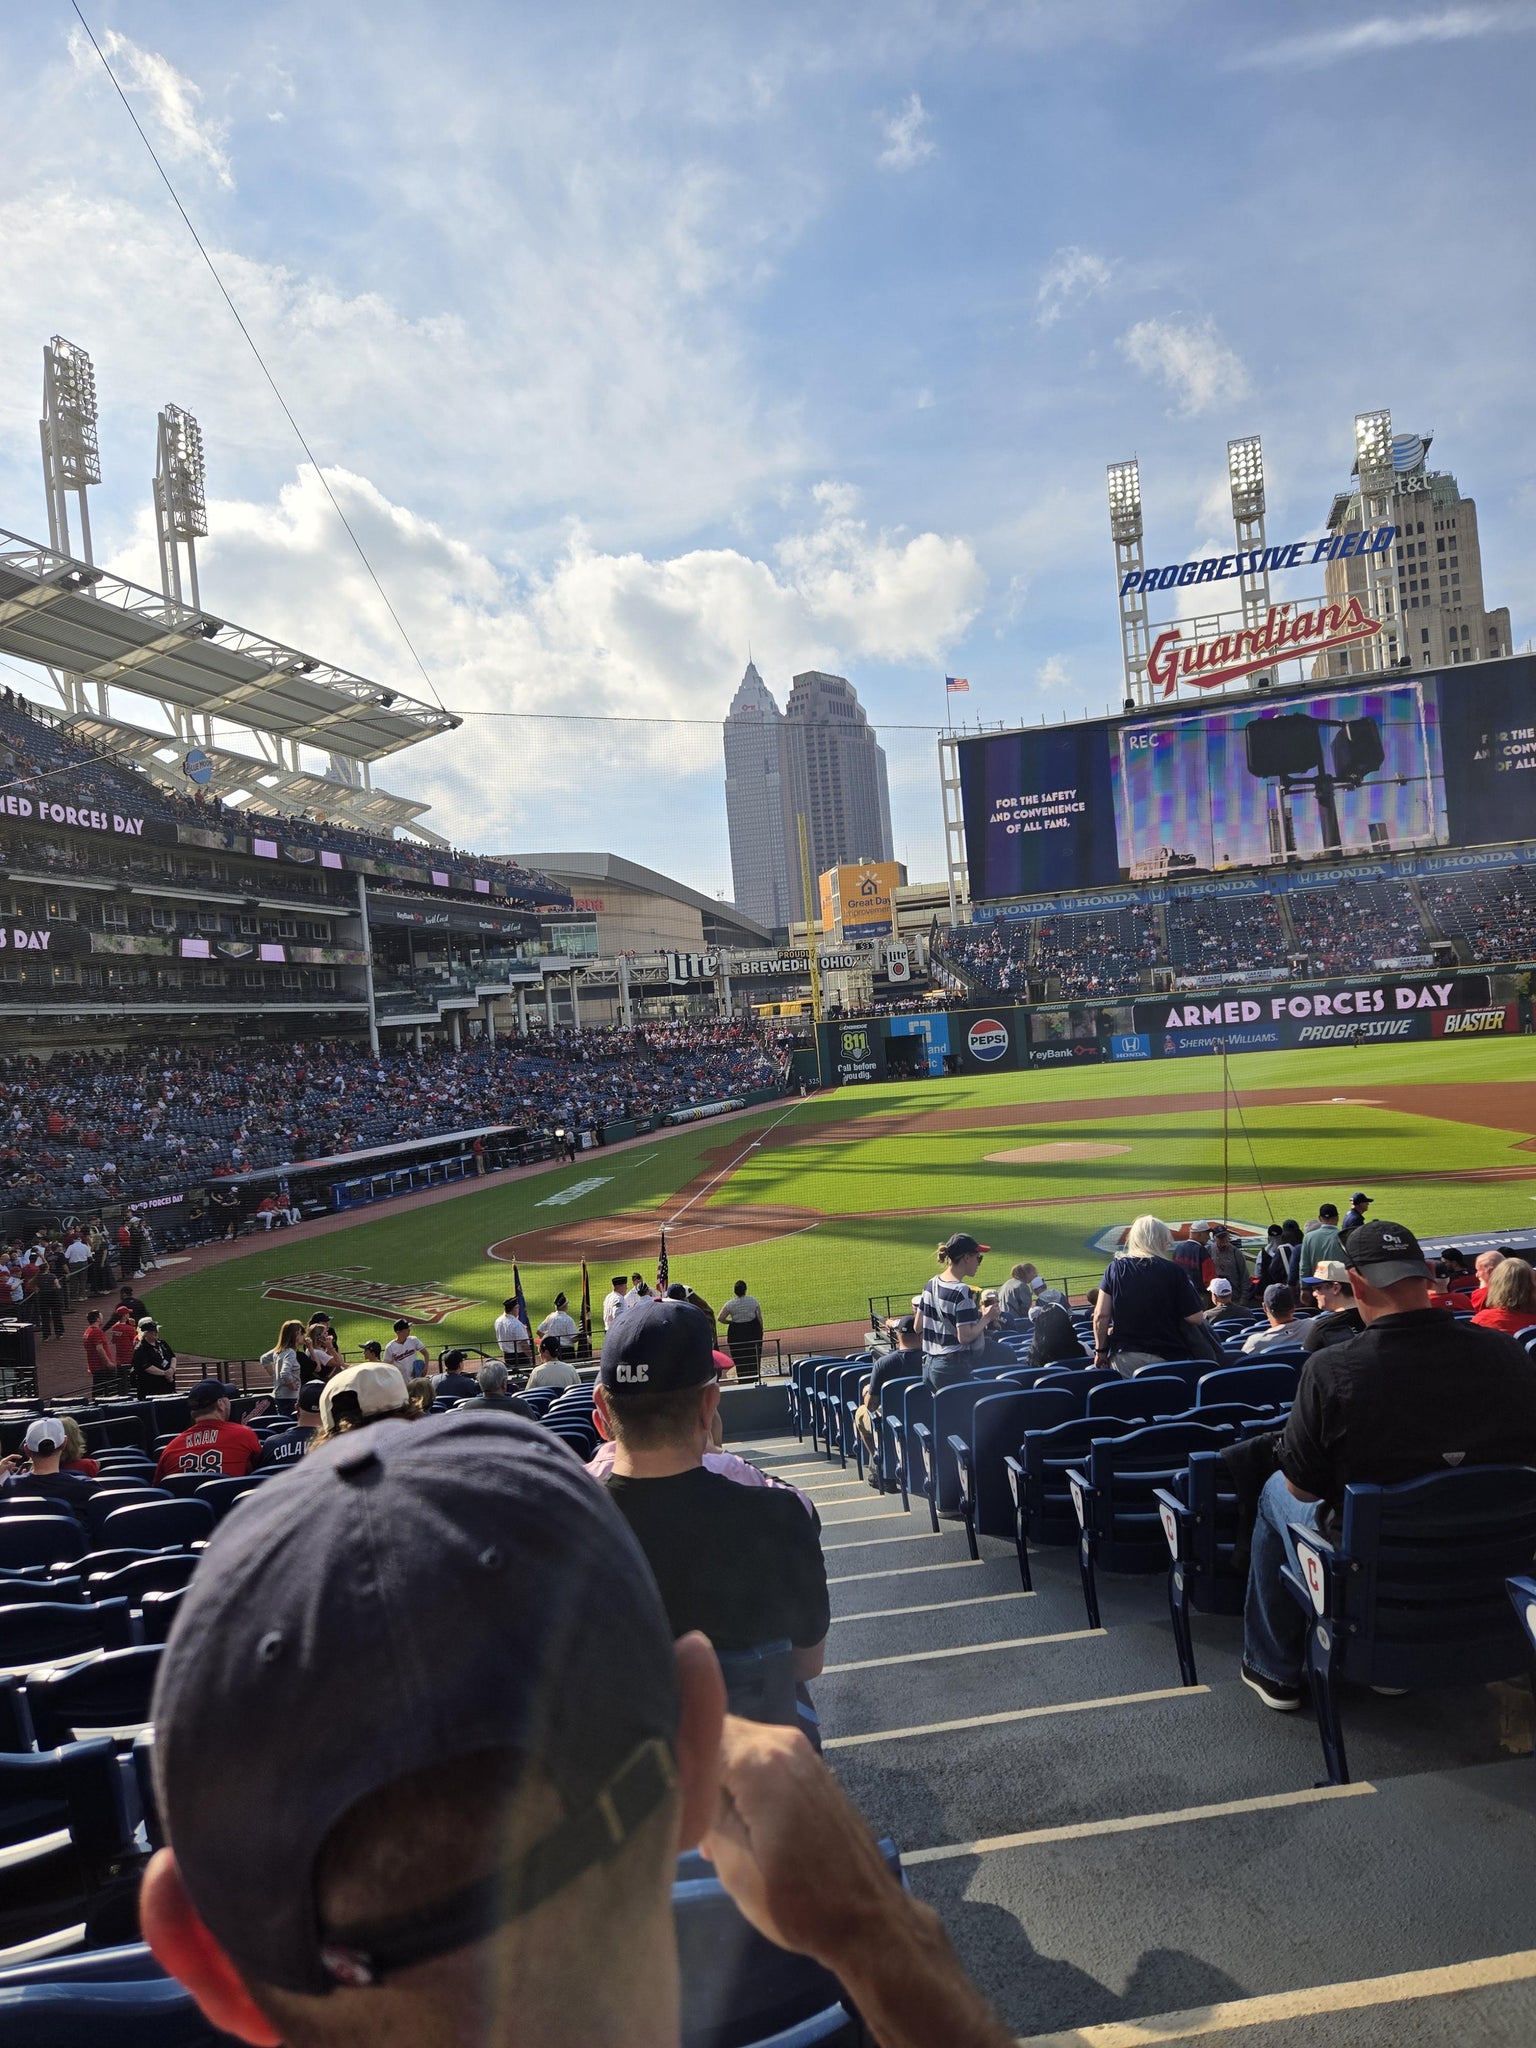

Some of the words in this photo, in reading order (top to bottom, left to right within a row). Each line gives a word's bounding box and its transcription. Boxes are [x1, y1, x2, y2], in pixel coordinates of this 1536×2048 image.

[1395, 471, 1432, 494] t&t
[1119, 541, 1307, 597] PROGRESSIVE
[1313, 526, 1396, 563] FIELD
[1146, 597, 1384, 699] Guardians
[1129, 733, 1160, 750] REC
[1511, 728, 1535, 740] THE
[996, 798, 1018, 809] FOR
[1020, 795, 1039, 806] THE
[1041, 790, 1077, 804] SAFETY
[39, 801, 109, 830] FORCES
[113, 815, 144, 836] DAY
[990, 812, 1011, 823] AND
[1013, 802, 1086, 820] CONVENIENCE
[1006, 823, 1021, 834] OF
[1023, 821, 1042, 832] ALL
[1044, 818, 1071, 830] FANS,
[1443, 851, 1519, 867] HONDA
[1314, 865, 1386, 881] HONDA
[1191, 879, 1260, 895] HONDA
[848, 899, 873, 908] Great
[1075, 892, 1141, 907] HONDA
[994, 902, 1057, 916] HONDA
[14, 929, 51, 949] DAY
[889, 950, 907, 962] Lite
[665, 953, 718, 985] Lite
[741, 959, 800, 975] BREWED
[820, 955, 853, 969] OHIO
[1457, 966, 1496, 975] PROGRESSIVE
[1344, 976, 1383, 985] PROGRESSIVE
[1400, 971, 1440, 980] PROGRESSIVE
[1165, 1001, 1261, 1028] ARMED
[1272, 988, 1385, 1020] FORCES
[1395, 983, 1454, 1010] DAY
[1298, 1019, 1413, 1042] PROGRESSIVE
[1443, 1011, 1505, 1034] BLASTER
[843, 1033, 867, 1051] 811
[970, 1034, 1006, 1046] PEPSI
[1029, 1048, 1073, 1060] KeyBank
[1115, 1051, 1147, 1059] HONDA
[837, 1064, 852, 1072] Call
[853, 1062, 877, 1071] before
[149, 1196, 171, 1208] FORCES
[172, 1194, 184, 1204] DAY
[616, 1364, 650, 1383] CLE
[185, 1429, 219, 1449] KWAN
[179, 1449, 223, 1474] 38
